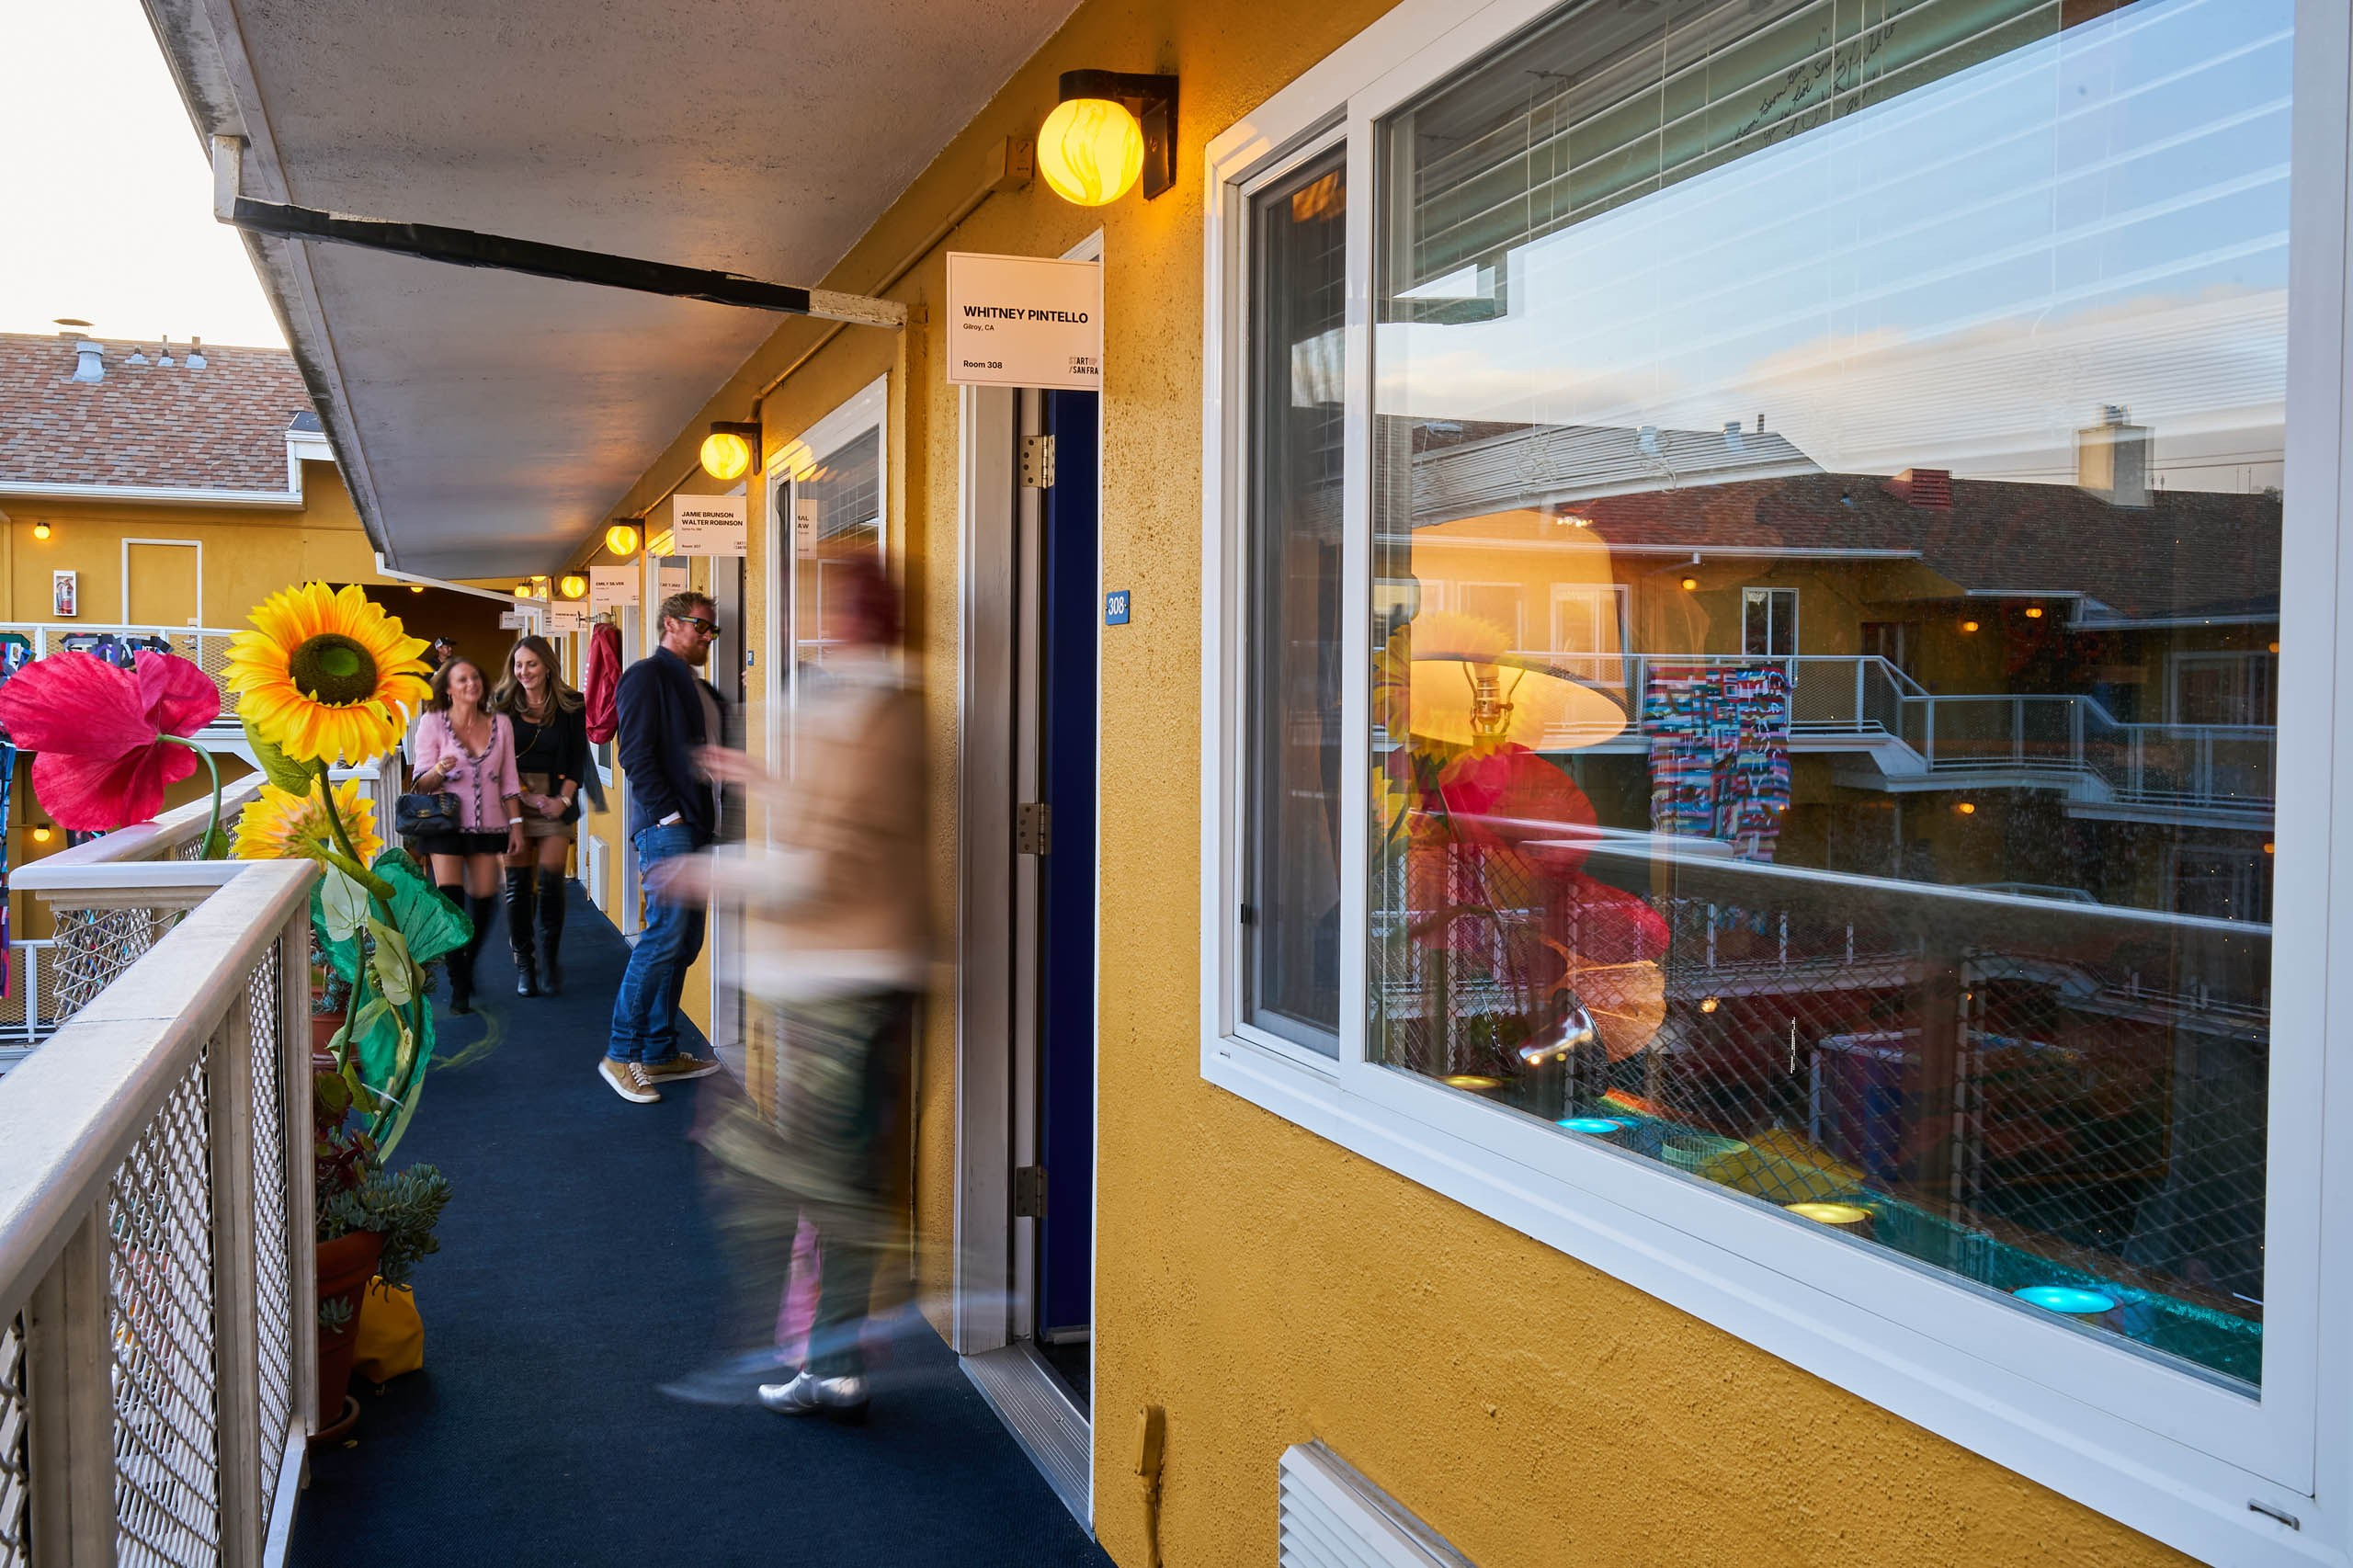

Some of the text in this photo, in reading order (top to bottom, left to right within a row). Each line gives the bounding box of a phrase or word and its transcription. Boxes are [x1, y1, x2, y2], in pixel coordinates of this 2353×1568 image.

[963, 305, 1088, 324] WHITNEY PINTELLO
[963, 323, 983, 332] Gilroy,
[963, 360, 1003, 369] Room 308
[1108, 596, 1124, 615] 308
